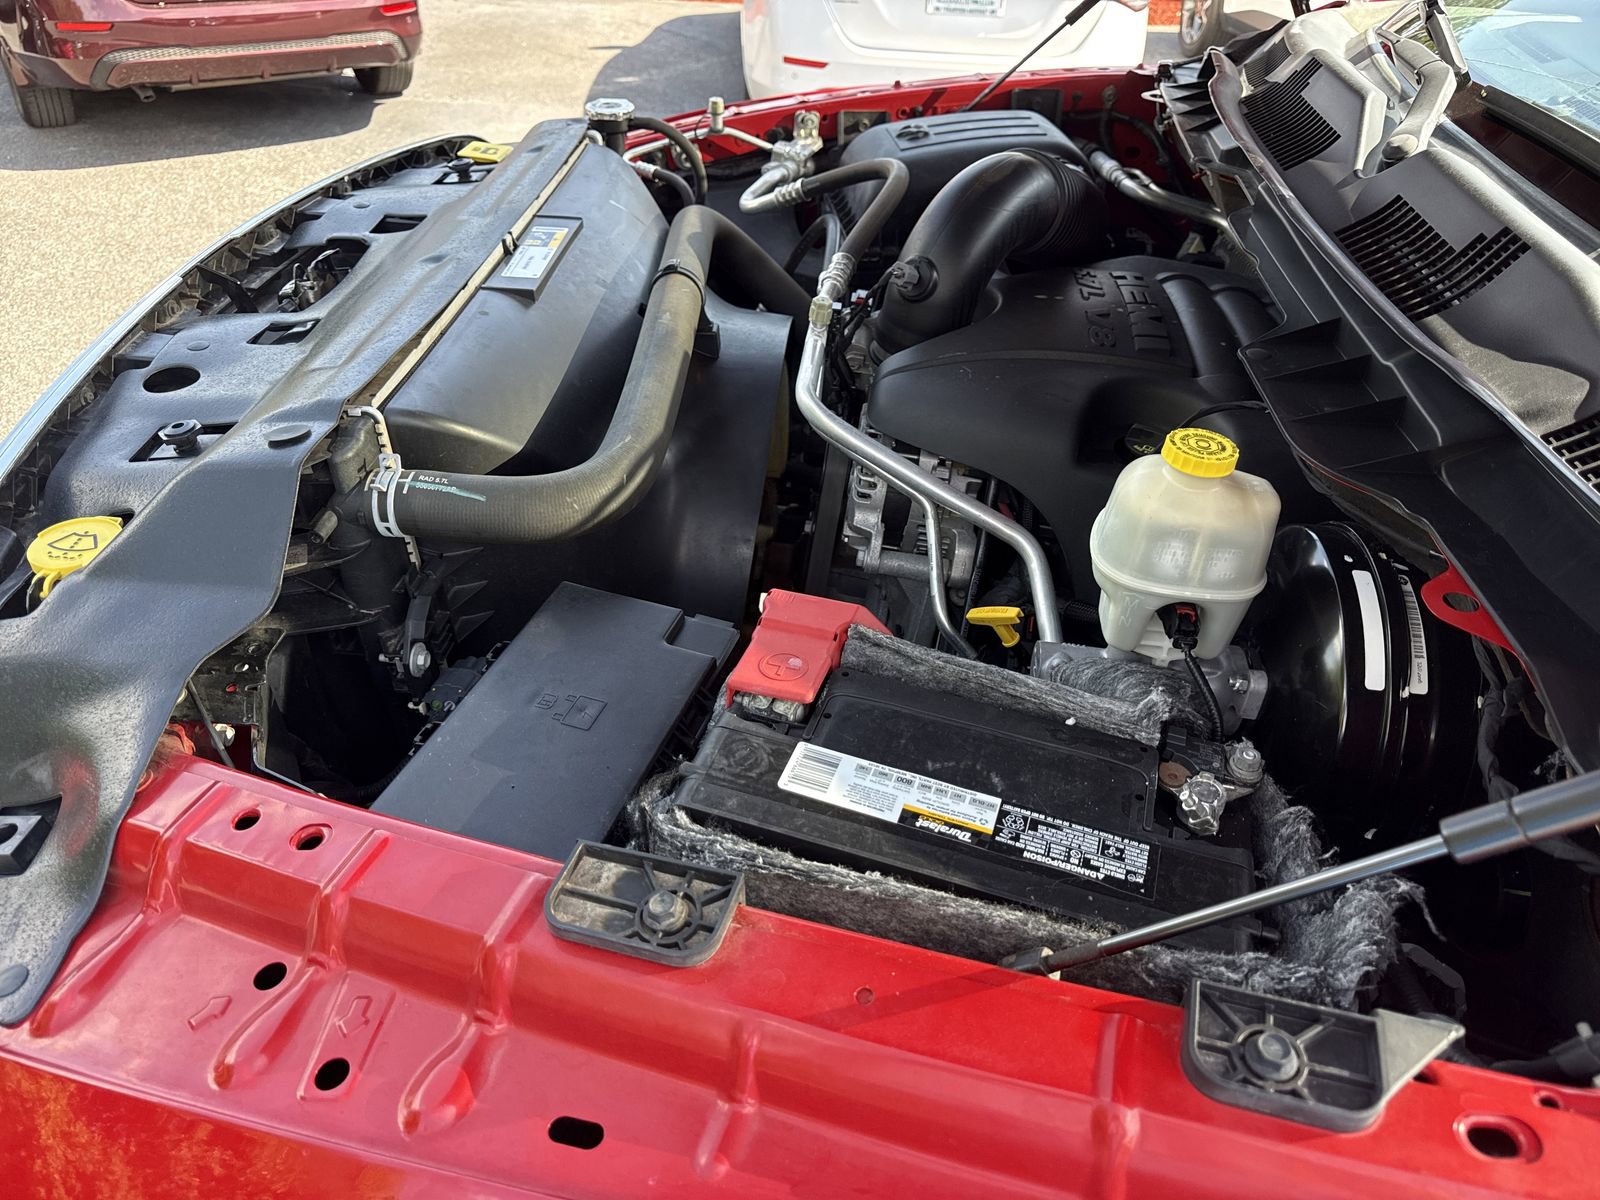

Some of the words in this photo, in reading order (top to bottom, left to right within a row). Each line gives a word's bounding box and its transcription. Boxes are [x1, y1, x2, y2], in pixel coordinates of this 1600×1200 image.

[1109, 271, 1171, 354] HEMI
[1085, 309, 1117, 347] V8
[896, 775, 912, 786] 800
[914, 817, 973, 842] Duralast
[1022, 850, 1097, 878] DANGER/POISON
[1069, 856, 1079, 864] NO
